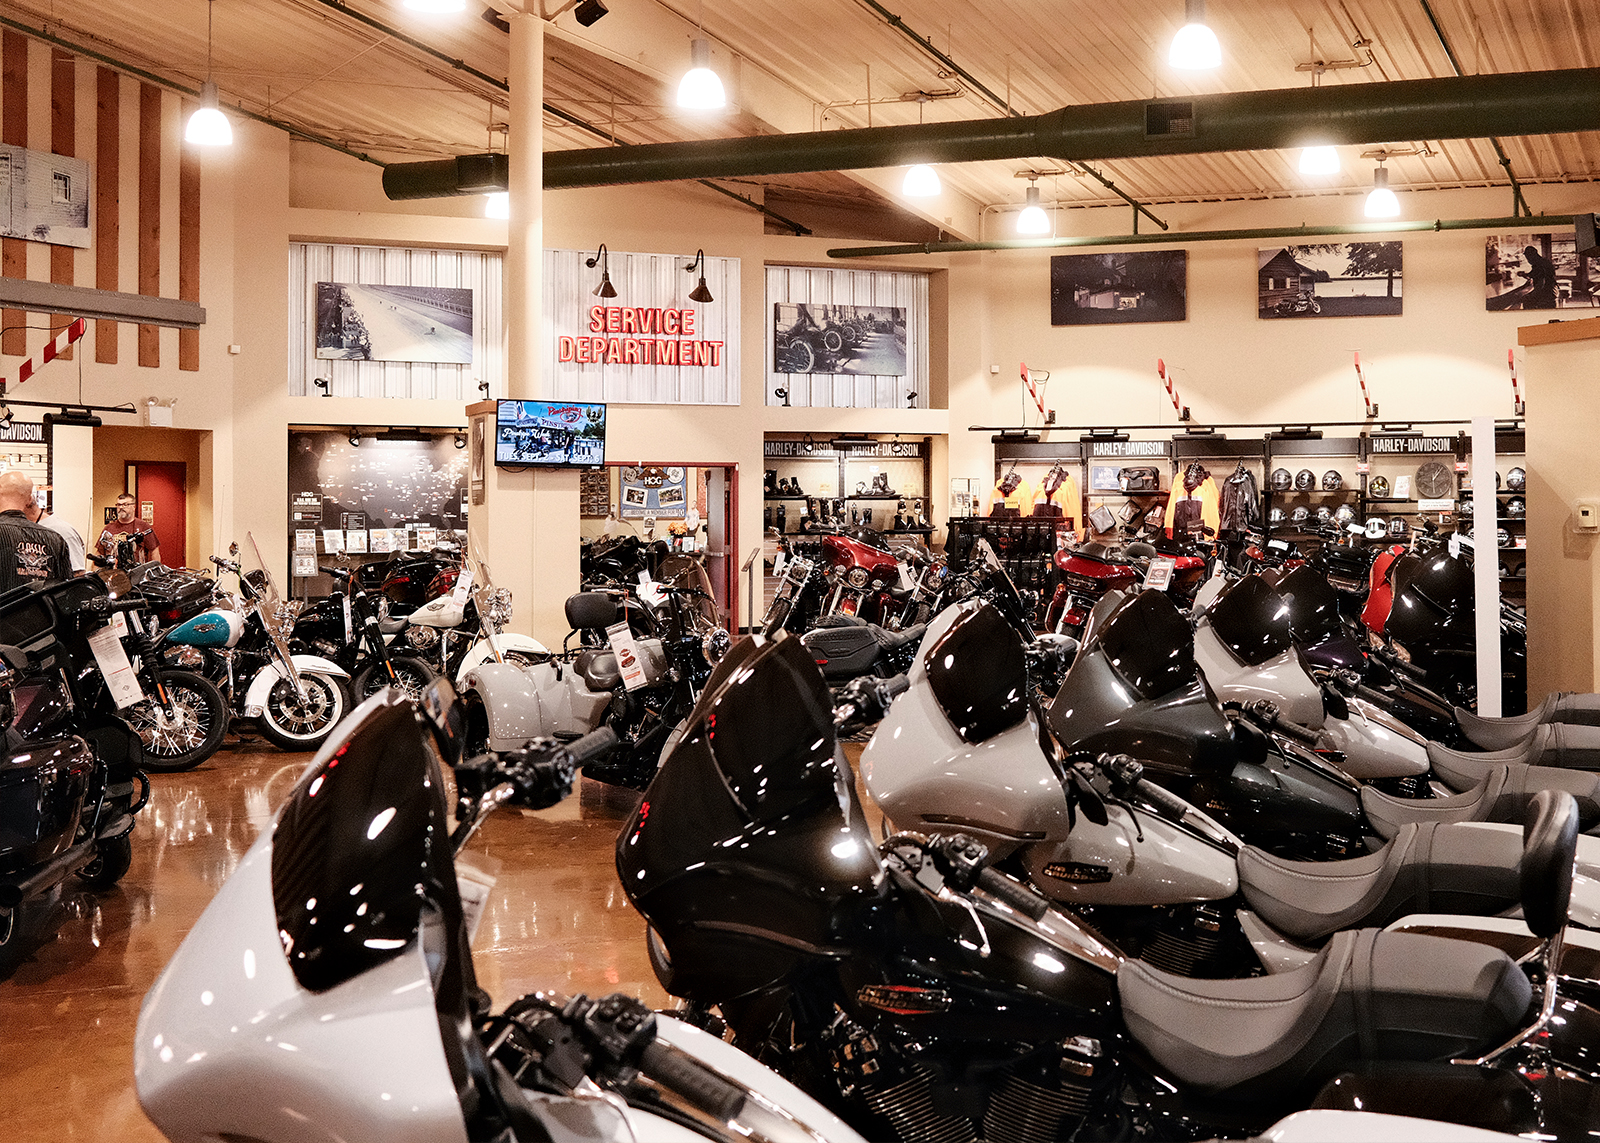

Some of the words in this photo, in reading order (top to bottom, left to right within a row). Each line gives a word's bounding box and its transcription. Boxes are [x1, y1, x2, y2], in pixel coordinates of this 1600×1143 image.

[589, 305, 695, 335] SERVICE
[558, 336, 724, 366] DEPARTMENT
[1093, 441, 1164, 456] HARLEY-DAVIDSON
[1372, 438, 1450, 452] HARLEY-DAVIDSON
[644, 476, 662, 485] HOG
